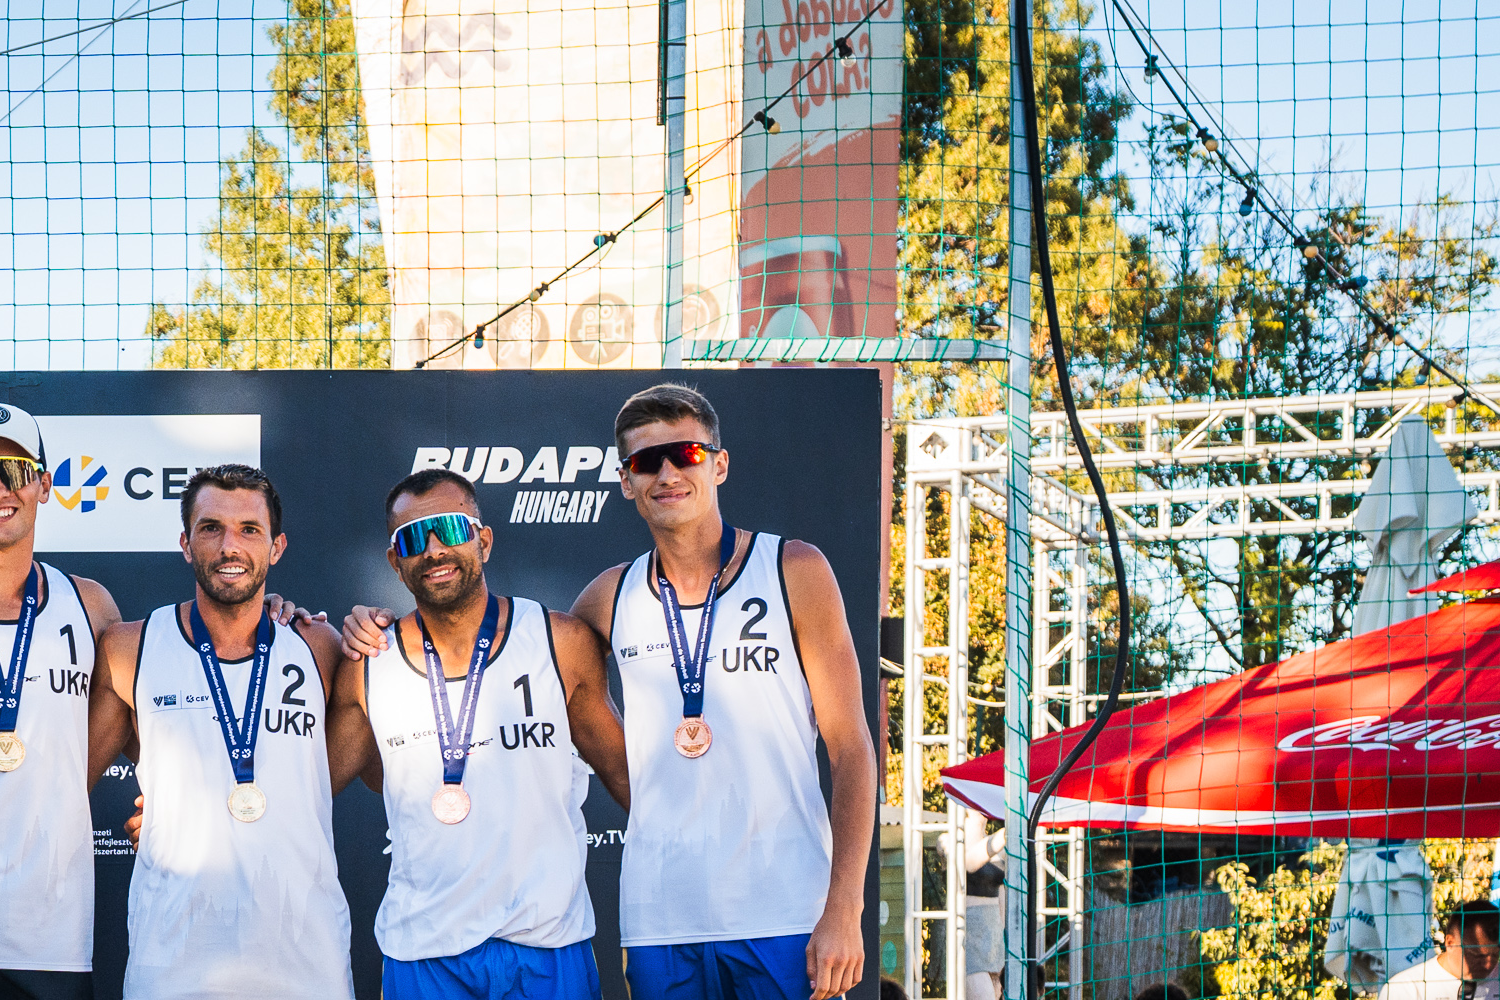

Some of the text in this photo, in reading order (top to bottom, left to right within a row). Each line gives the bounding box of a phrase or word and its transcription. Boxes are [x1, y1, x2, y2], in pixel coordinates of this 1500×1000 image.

[410, 446, 622, 484] BUDAPE
[124, 466, 203, 501] CE
[509, 490, 610, 524] HUNGARY
[739, 597, 768, 641] 2
[59, 623, 77, 665] 1
[722, 646, 780, 674] UKR
[49, 668, 89, 698] UKR
[281, 664, 306, 707] 2
[513, 673, 534, 718] 1
[264, 708, 316, 739] UKR
[499, 722, 556, 750] UKR
